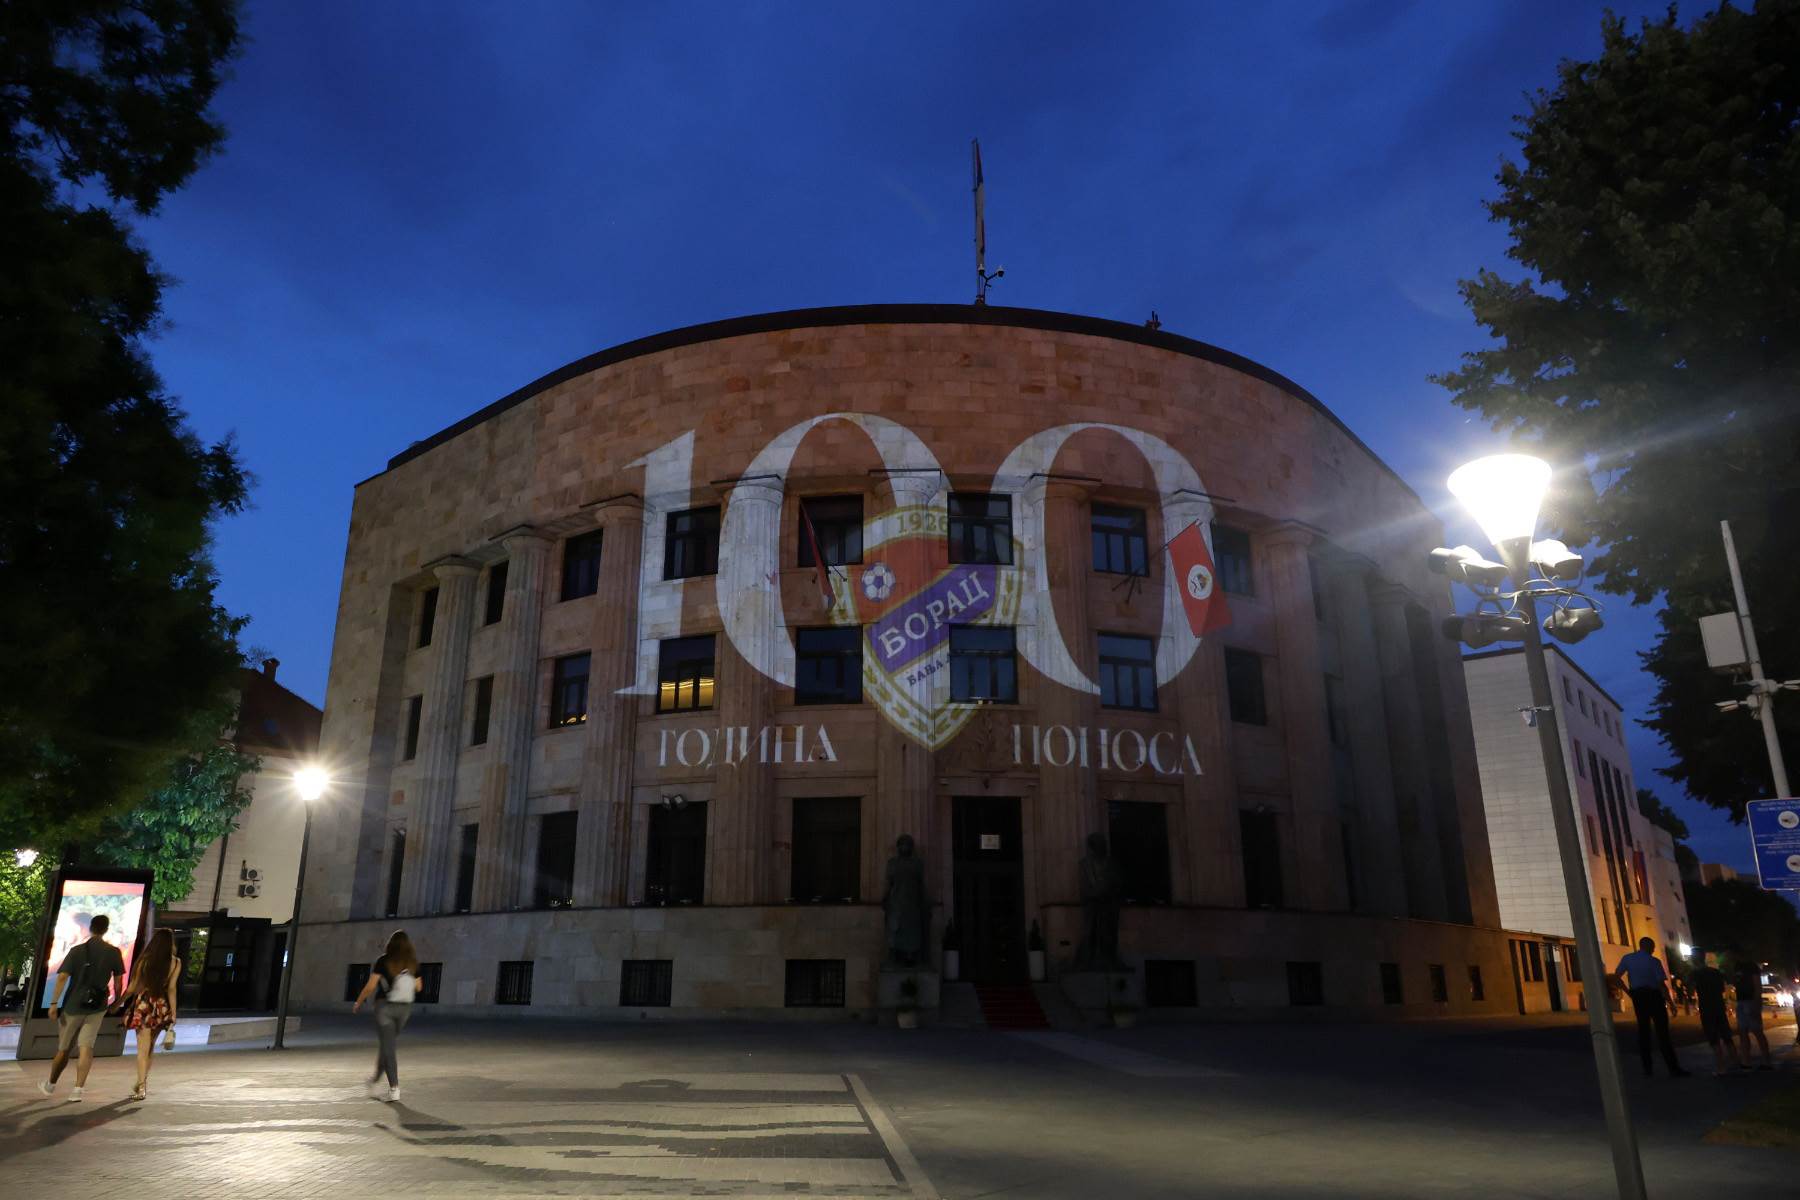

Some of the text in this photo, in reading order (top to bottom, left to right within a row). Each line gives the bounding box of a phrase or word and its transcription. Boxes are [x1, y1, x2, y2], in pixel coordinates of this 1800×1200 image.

[614, 412, 1214, 695] 100
[896, 512, 949, 534] 1926
[878, 571, 990, 658] БОРАЦ
[658, 723, 1205, 775] ГОДИНА ПОНОСА
